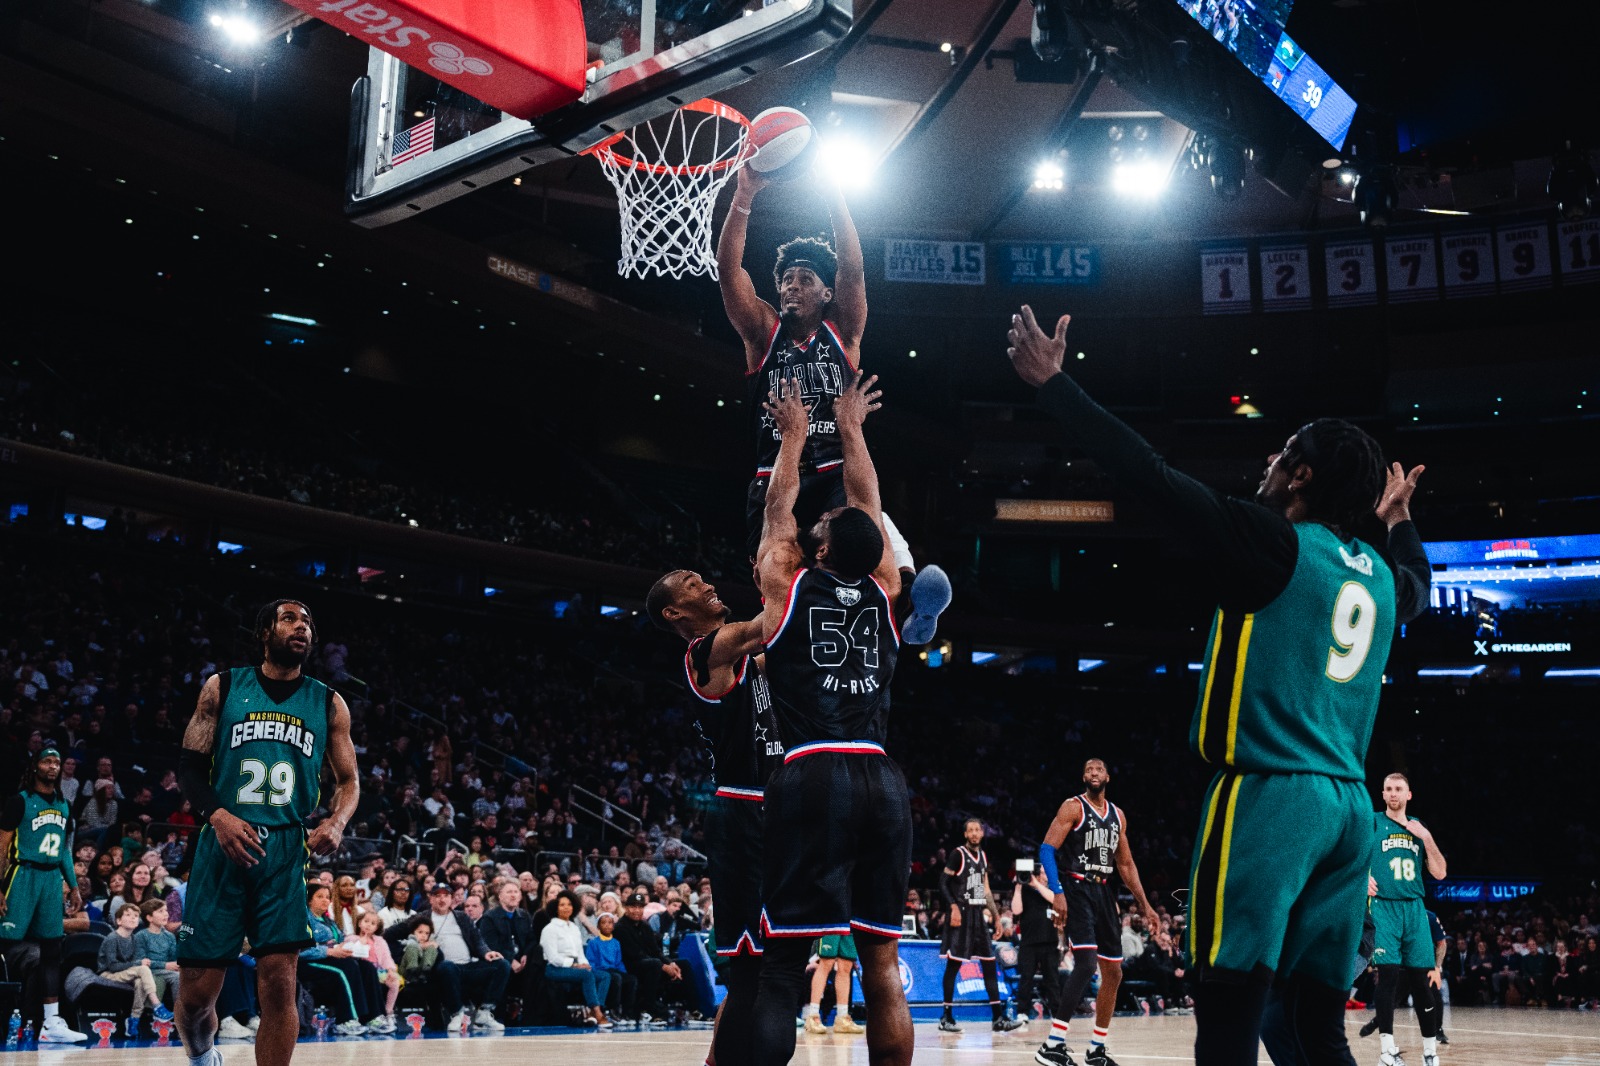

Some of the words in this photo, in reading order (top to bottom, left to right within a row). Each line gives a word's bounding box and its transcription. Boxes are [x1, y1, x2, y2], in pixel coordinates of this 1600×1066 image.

[1302, 80, 1322, 109] 39
[951, 245, 981, 273] 15
[1042, 246, 1091, 277] 145
[1457, 249, 1480, 281] 9
[1512, 242, 1535, 275] 9
[1569, 233, 1599, 268] 11
[488, 257, 537, 286] CHASE
[1219, 269, 1233, 299] 1
[1275, 265, 1297, 296] 2
[1341, 260, 1362, 291] 3
[1401, 254, 1421, 286] 7
[809, 606, 880, 668] 54
[1325, 580, 1377, 683] 9
[1491, 643, 1571, 653] @THEGARDEN
[823, 674, 881, 694] HI-RISE
[249, 712, 303, 727] WASHINGTON
[230, 721, 315, 758] GENERALS
[236, 758, 296, 806] 29
[38, 833, 61, 857] 42
[1099, 847, 1109, 866] 5
[1389, 856, 1416, 882] 18
